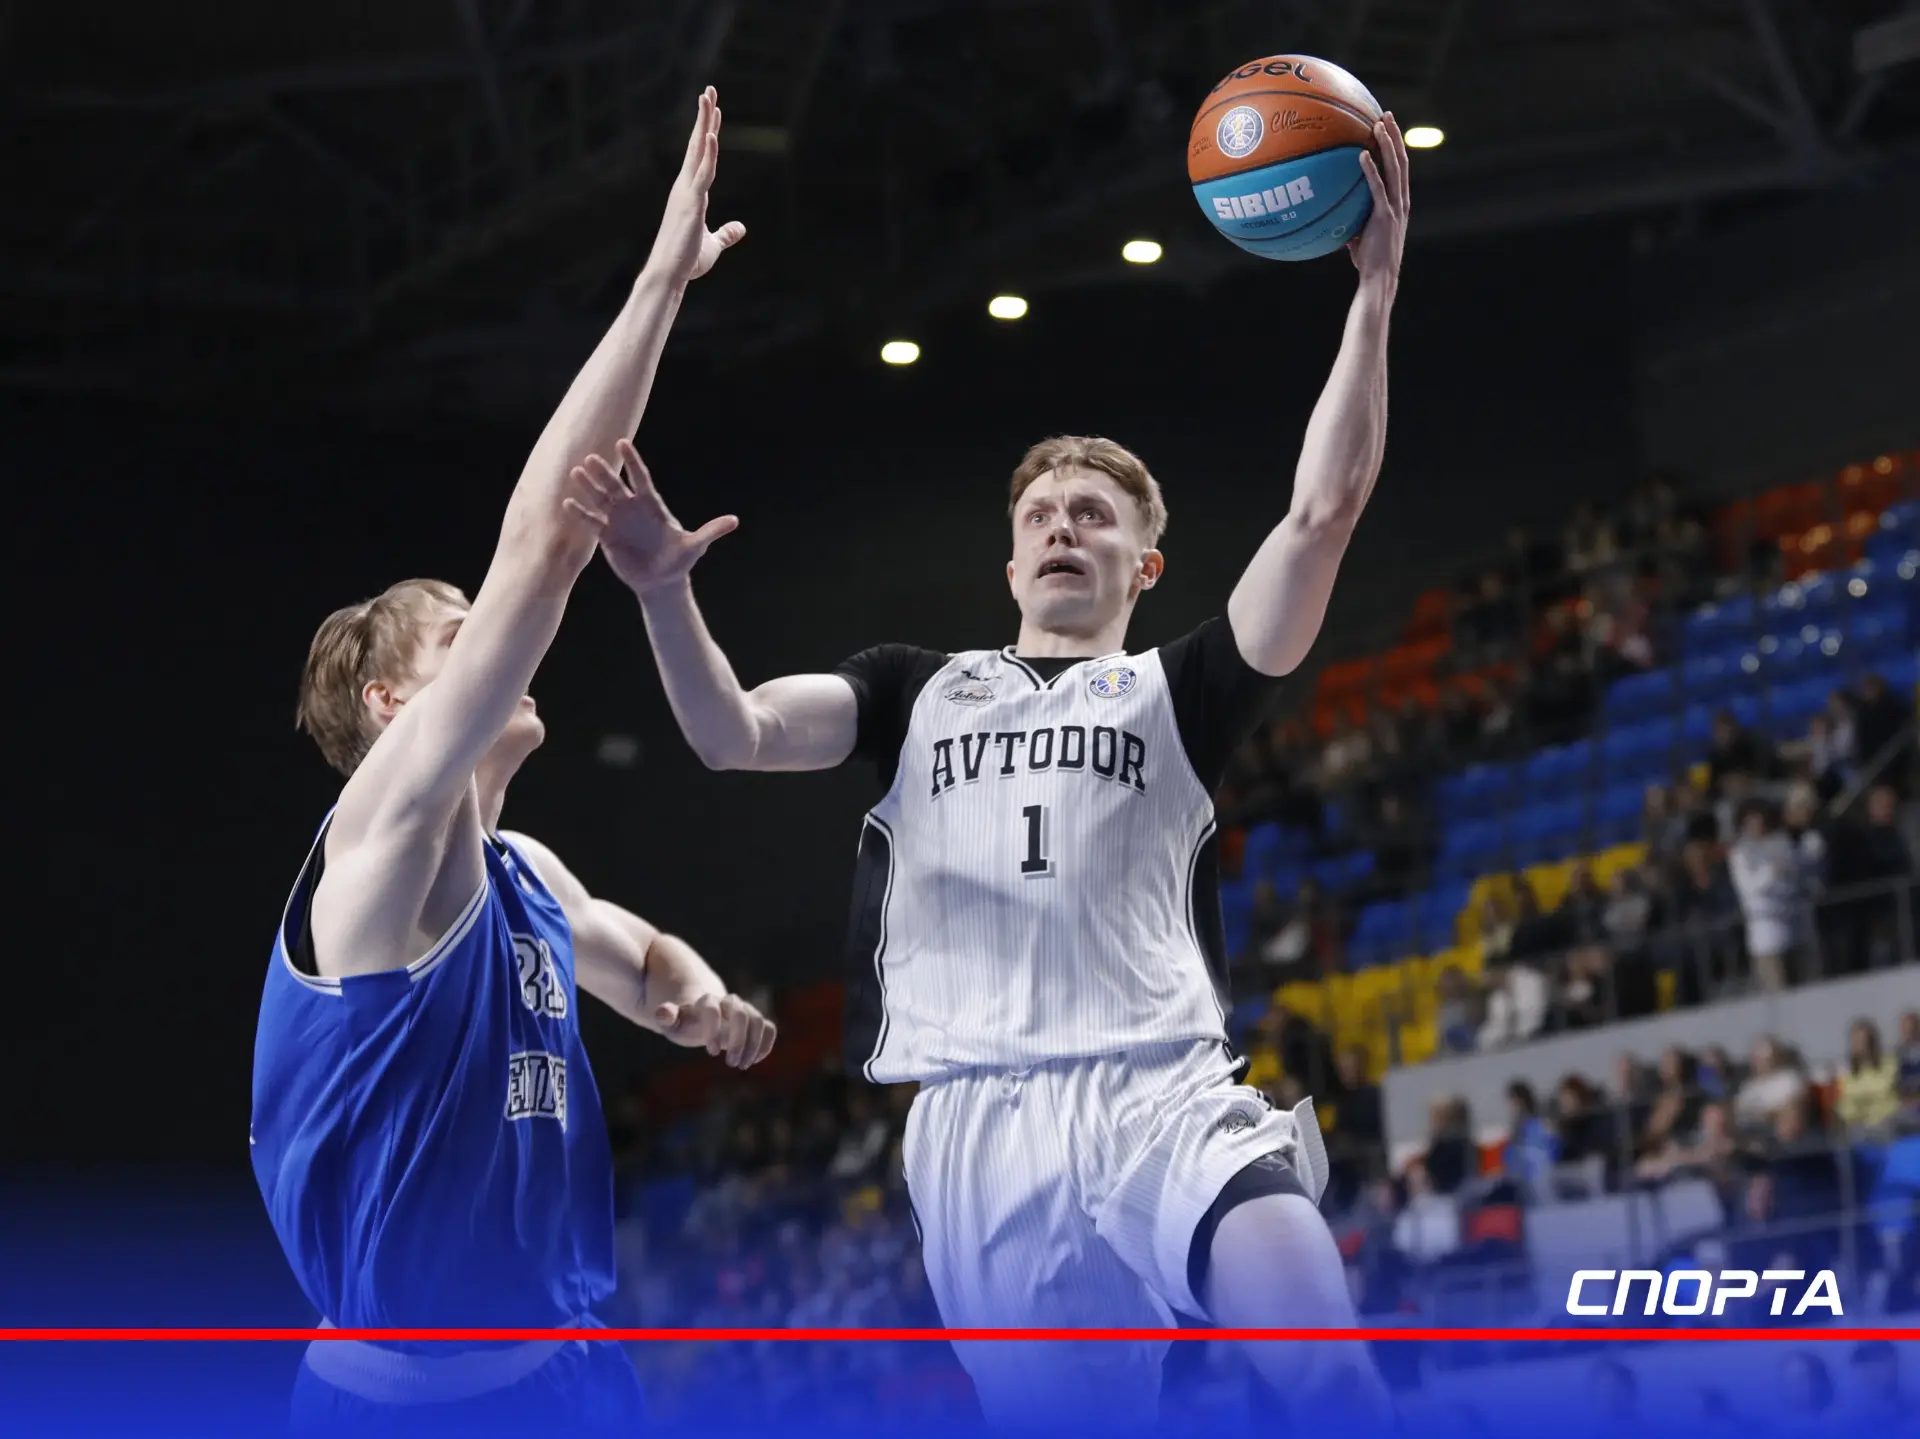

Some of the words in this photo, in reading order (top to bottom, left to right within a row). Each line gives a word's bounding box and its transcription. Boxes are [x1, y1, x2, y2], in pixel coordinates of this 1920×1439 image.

[1212, 175, 1315, 219] SIBUR
[931, 725, 1147, 799] AVTODOR
[1021, 804, 1053, 876] 1
